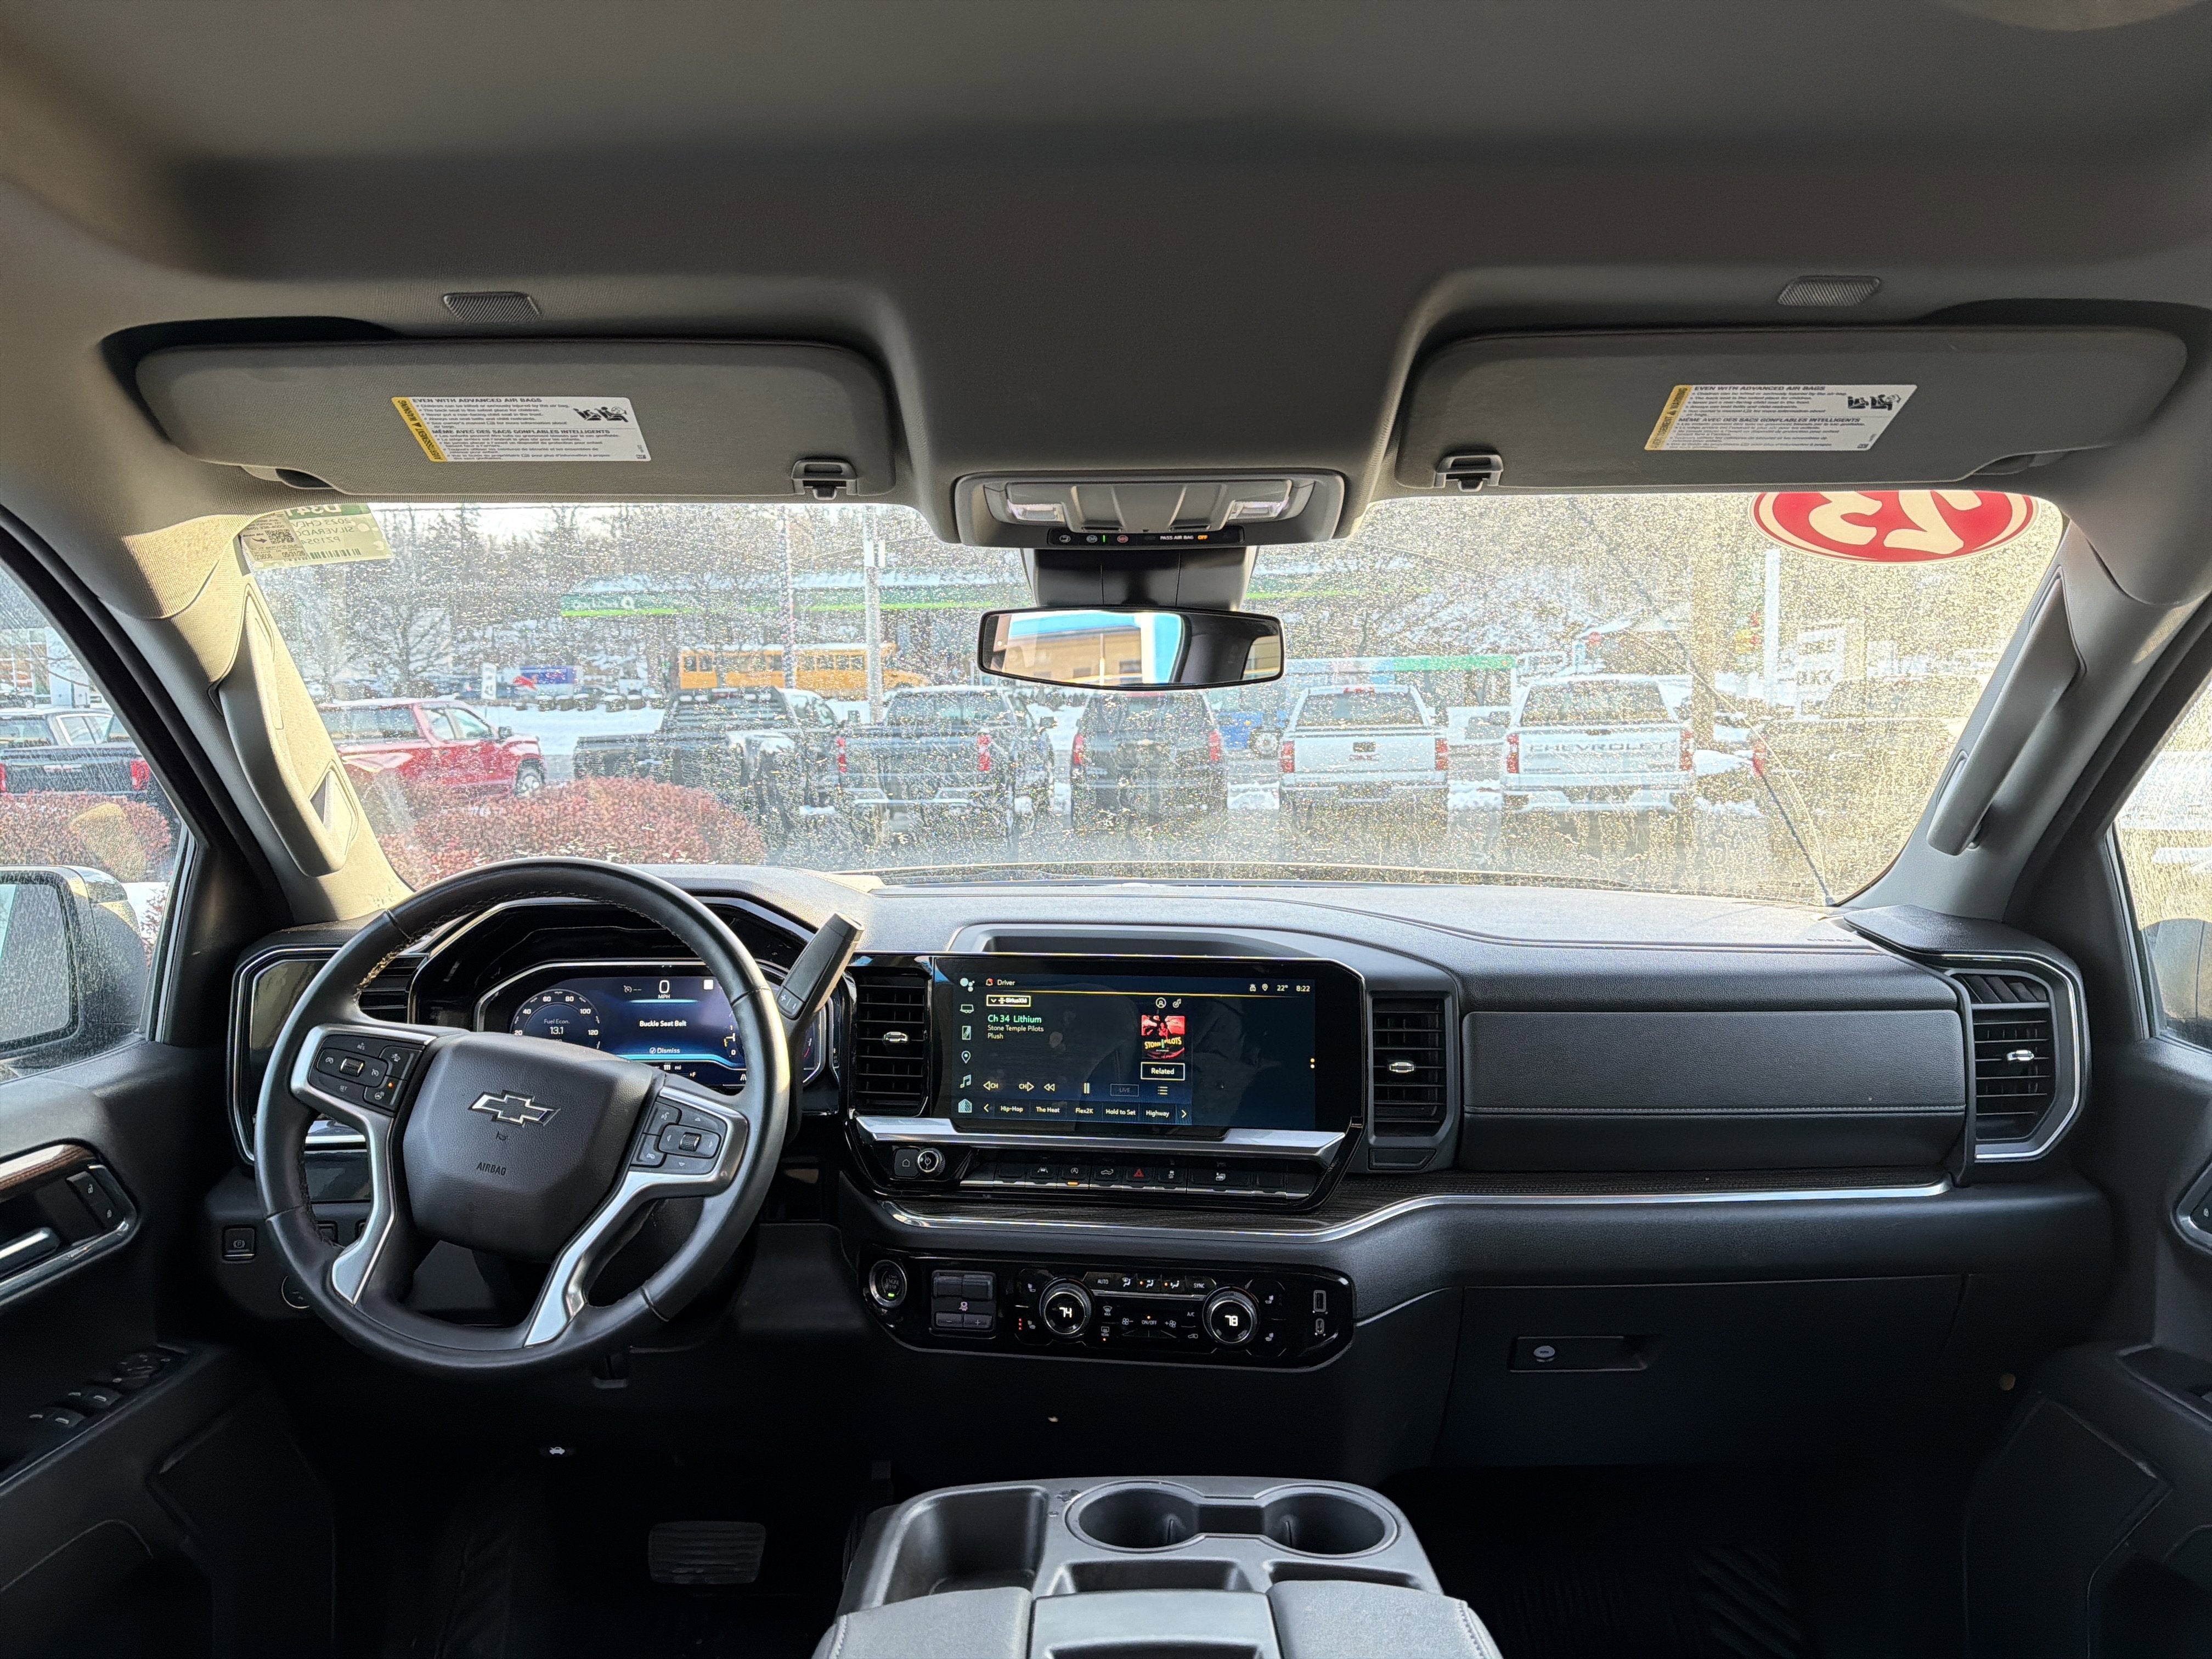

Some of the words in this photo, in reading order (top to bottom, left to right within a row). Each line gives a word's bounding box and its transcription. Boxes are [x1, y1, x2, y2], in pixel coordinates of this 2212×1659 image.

[659, 980, 670, 994] 0
[988, 1014, 998, 1023] Ch
[1000, 1014, 1010, 1023] 34
[1013, 1015, 1042, 1023] Lithium
[550, 1026, 563, 1035] 13.1
[476, 1162, 506, 1176] AIRBAG
[1059, 1307, 1072, 1318] 74
